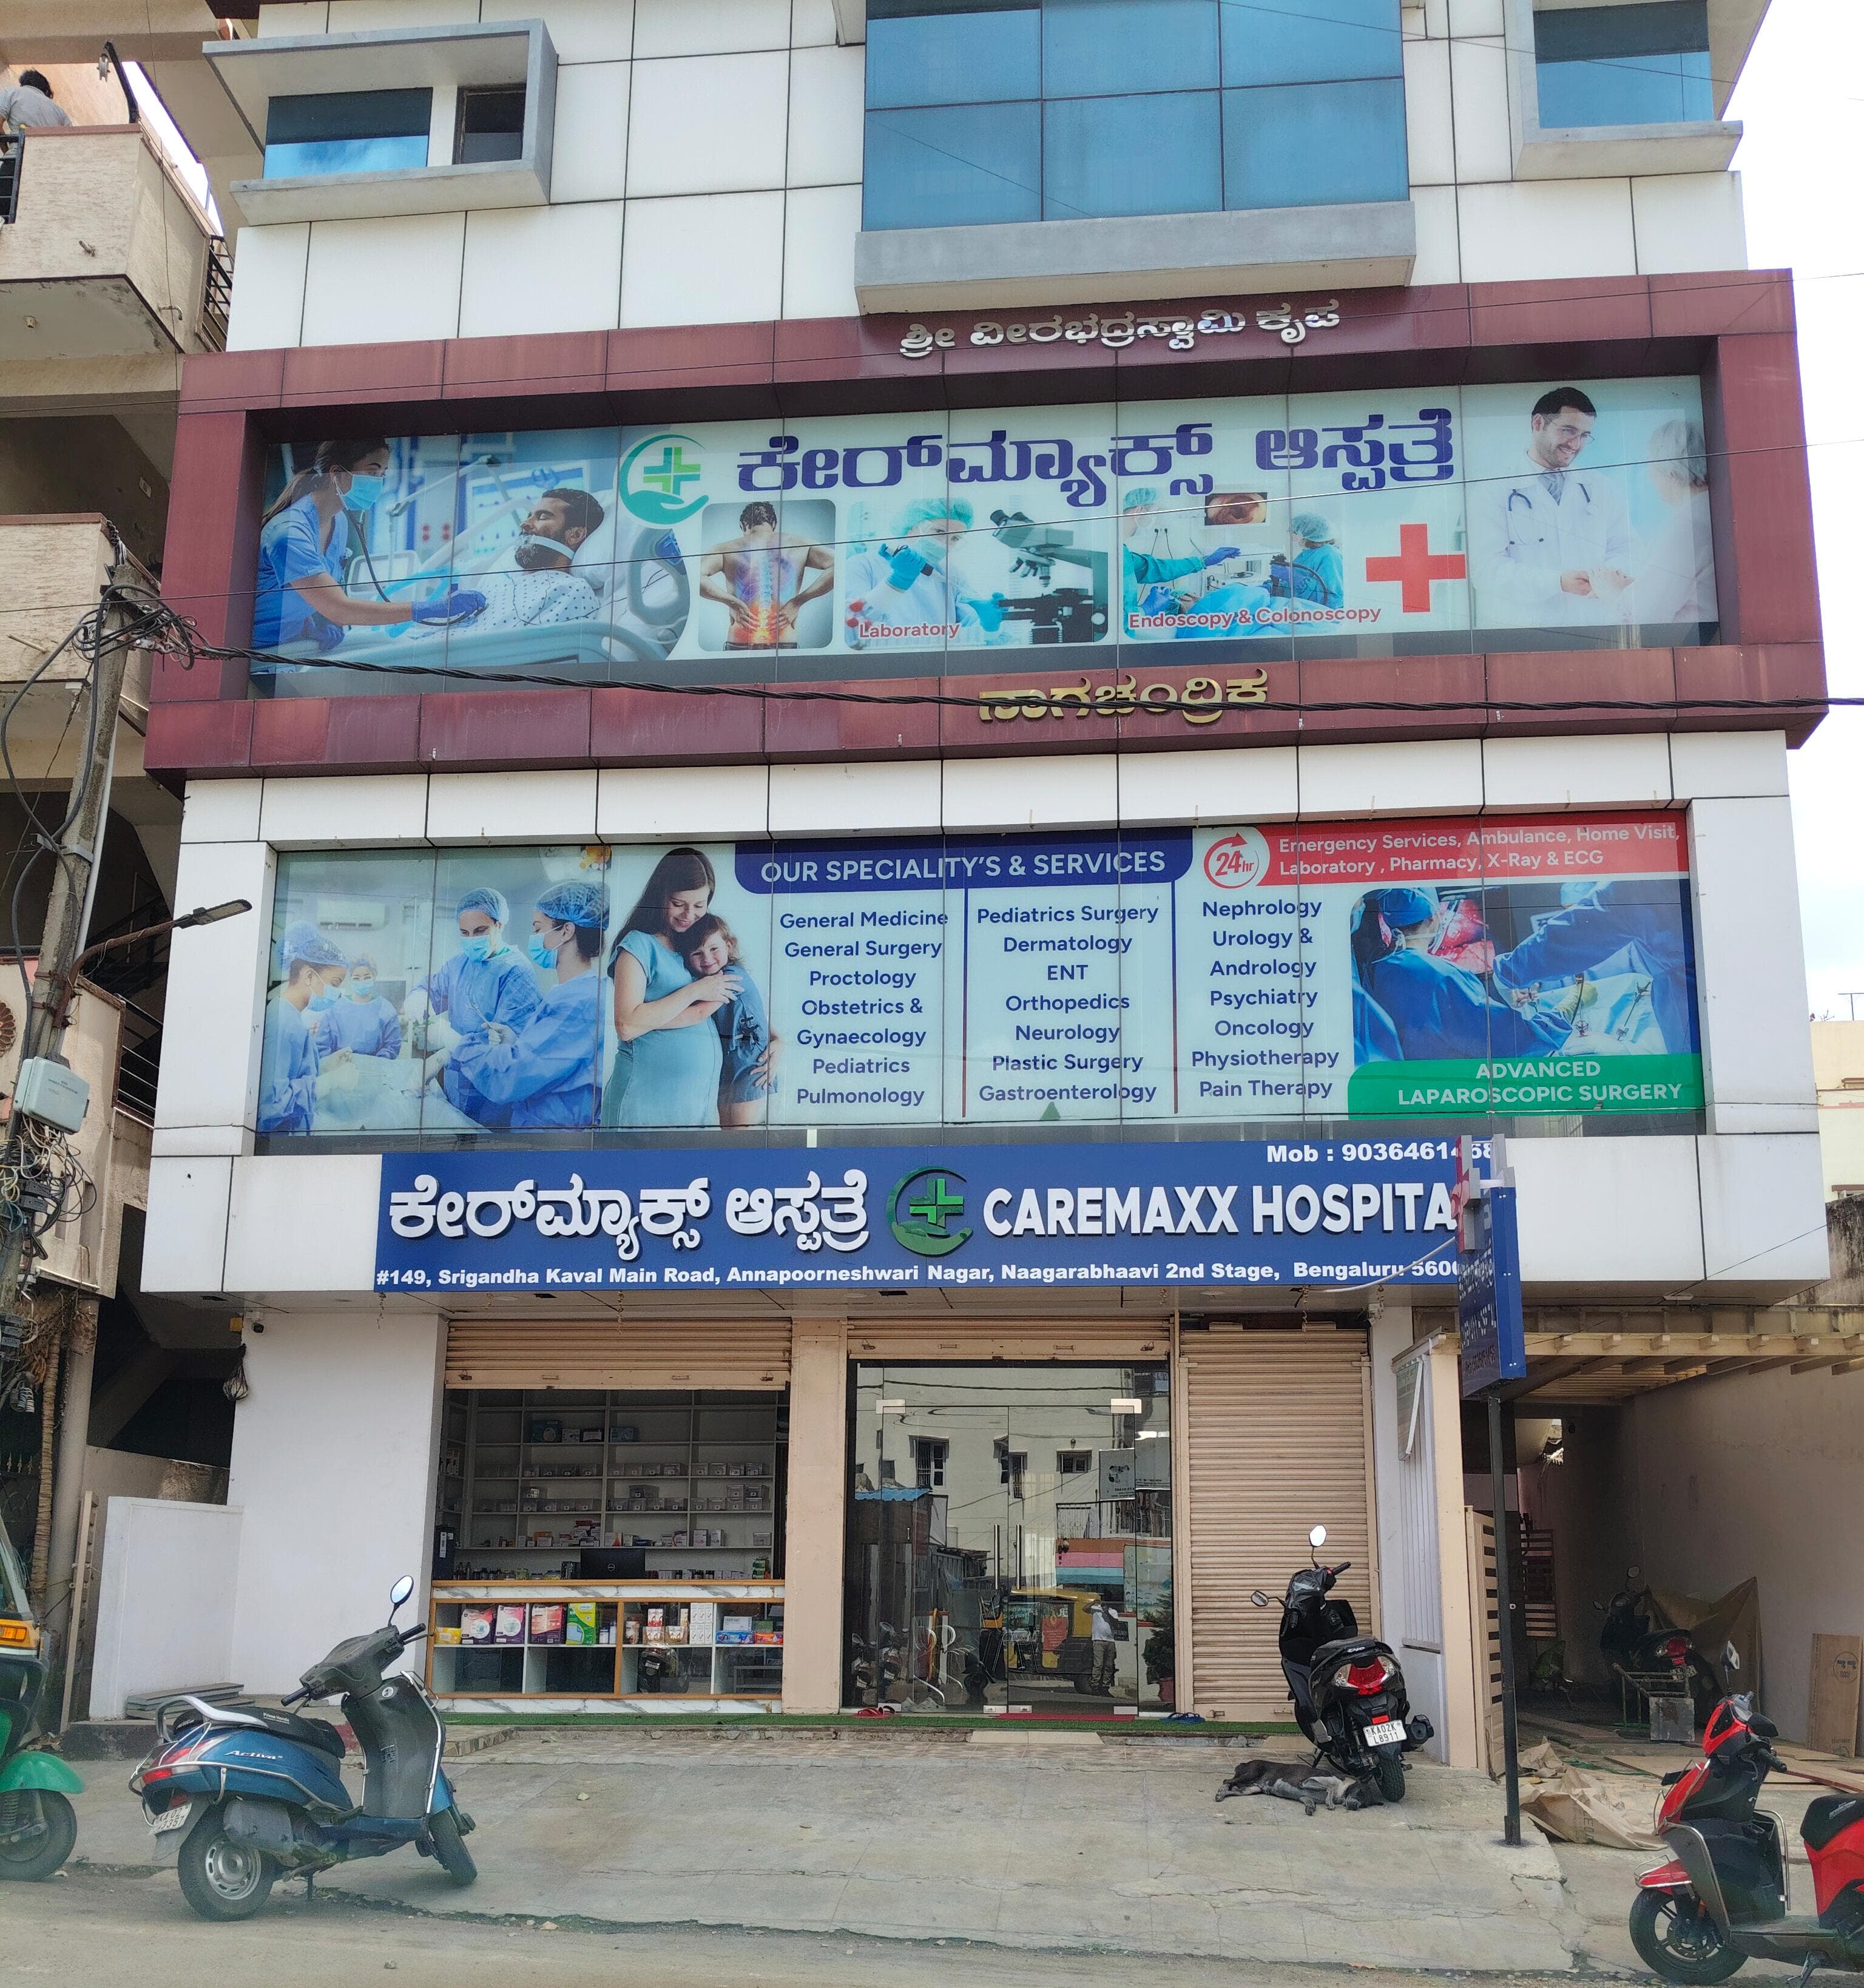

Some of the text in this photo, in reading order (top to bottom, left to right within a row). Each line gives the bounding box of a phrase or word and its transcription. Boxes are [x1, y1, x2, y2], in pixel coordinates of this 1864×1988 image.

[900, 324, 955, 357] ಶ್ರೀ
[1255, 408, 1454, 491] ಆಸ್ಪತ್ರೆ
[1129, 607, 1381, 629] Endoscopy & Colonoscopy
[860, 621, 959, 639] Laboratory
[1280, 823, 1680, 856] Emergency Services, Ambulance, Home Visit,
[761, 861, 818, 882] OUR
[1008, 856, 1026, 876] &
[1034, 851, 1166, 874] SERVICES
[1280, 859, 1373, 877] Laboratory
[1390, 853, 1482, 873] Pharmacy,
[1487, 850, 1542, 869] X-Ray
[1547, 851, 1559, 866] &
[1564, 850, 1604, 865] ECG
[978, 905, 1158, 925] Pediatrics Surgery
[1203, 899, 1322, 919] Nephrology
[780, 910, 948, 929] General Medicine
[1004, 935, 1132, 955] Dermatology
[1214, 928, 1313, 948] Urology &
[785, 939, 942, 959] General Surgery
[1047, 965, 1088, 981] ENT
[1210, 959, 1317, 978] Andrology
[810, 970, 916, 989] Proctology
[802, 999, 923, 1016] Obstetrics &
[1005, 993, 1129, 1013] Orthopedics
[1210, 988, 1318, 1008] Psychiatry
[797, 1027, 926, 1049] Gynaecology
[1016, 1025, 1120, 1044] Neurology
[1215, 1019, 1314, 1038] Oncology
[813, 1057, 910, 1074] Pediatrics
[993, 1054, 1143, 1073] Plastic Surgery
[1192, 1049, 1339, 1069] Physiotherapy
[1476, 1061, 1601, 1080] ADVANCED
[797, 1087, 925, 1107] Pulmonology
[979, 1083, 1157, 1103] Gastroenterology
[1200, 1080, 1332, 1100] Pain Therapy
[1399, 1083, 1683, 1106] LAPAROSCOPIC SURGERY
[1267, 1145, 1318, 1163] Mob
[727, 1169, 868, 1252] ಆಸ್ಪತ್ರೆ
[983, 1185, 1238, 1237] CAREMAXX
[1253, 1182, 1457, 1234] HOSPITA
[377, 1270, 433, 1286] #149,
[439, 1268, 539, 1288] Srigandha
[547, 1269, 602, 1283] Kaval
[610, 1268, 658, 1283] Main
[664, 1268, 720, 1285] Road,
[727, 1265, 919, 1285] Annapoorneshwari
[928, 1265, 994, 1284] Nagar,
[1001, 1262, 1158, 1283] Naagarabhaavi
[1165, 1263, 1204, 1279] 2nd
[1211, 1262, 1280, 1283] Stage,
[1294, 1262, 1403, 1280] Bengaluru
[224, 1751, 277, 1760] Activa
